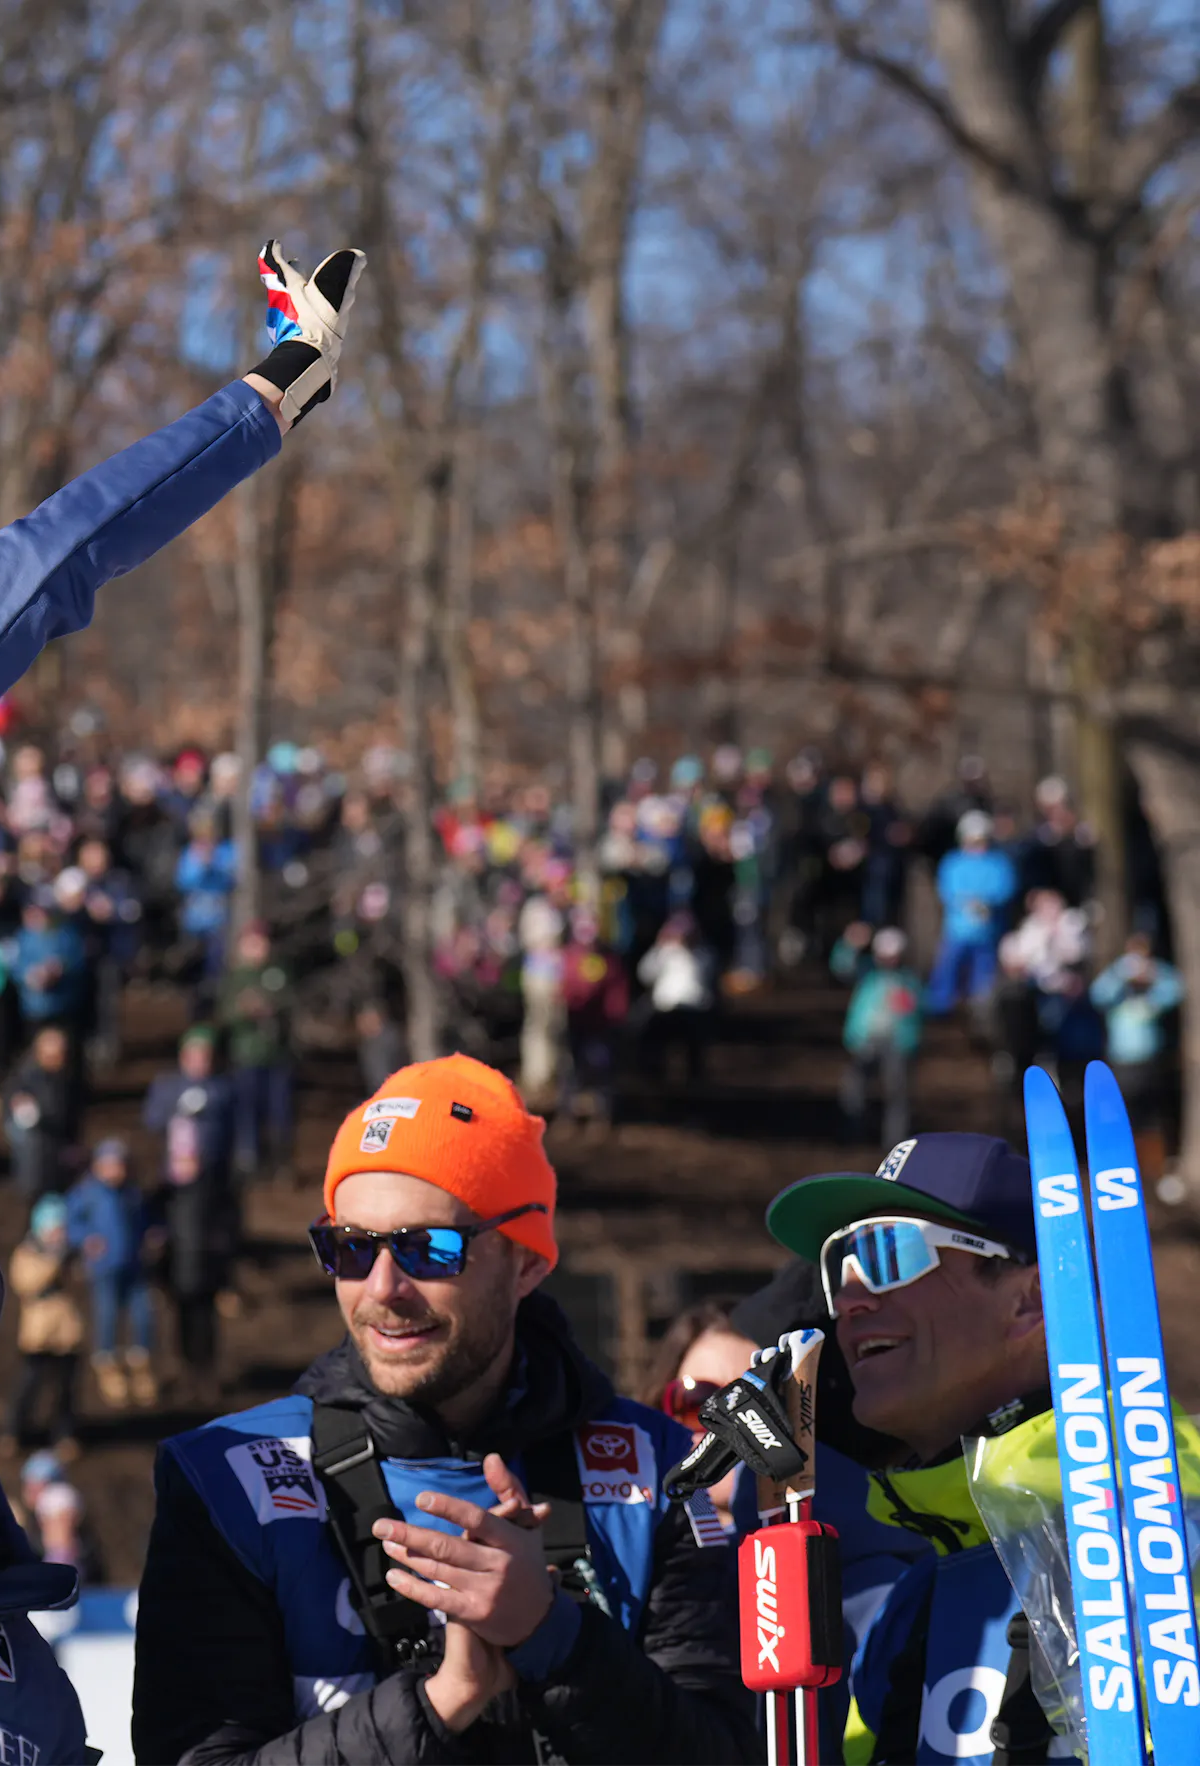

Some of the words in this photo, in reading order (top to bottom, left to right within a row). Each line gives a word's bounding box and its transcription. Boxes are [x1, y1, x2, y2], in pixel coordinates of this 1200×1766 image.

[1038, 1173, 1080, 1218] S
[1095, 1167, 1138, 1211] S
[252, 1449, 304, 1467] US
[1058, 1363, 1134, 1713] SALOMON
[1116, 1357, 1199, 1708] SALOMON
